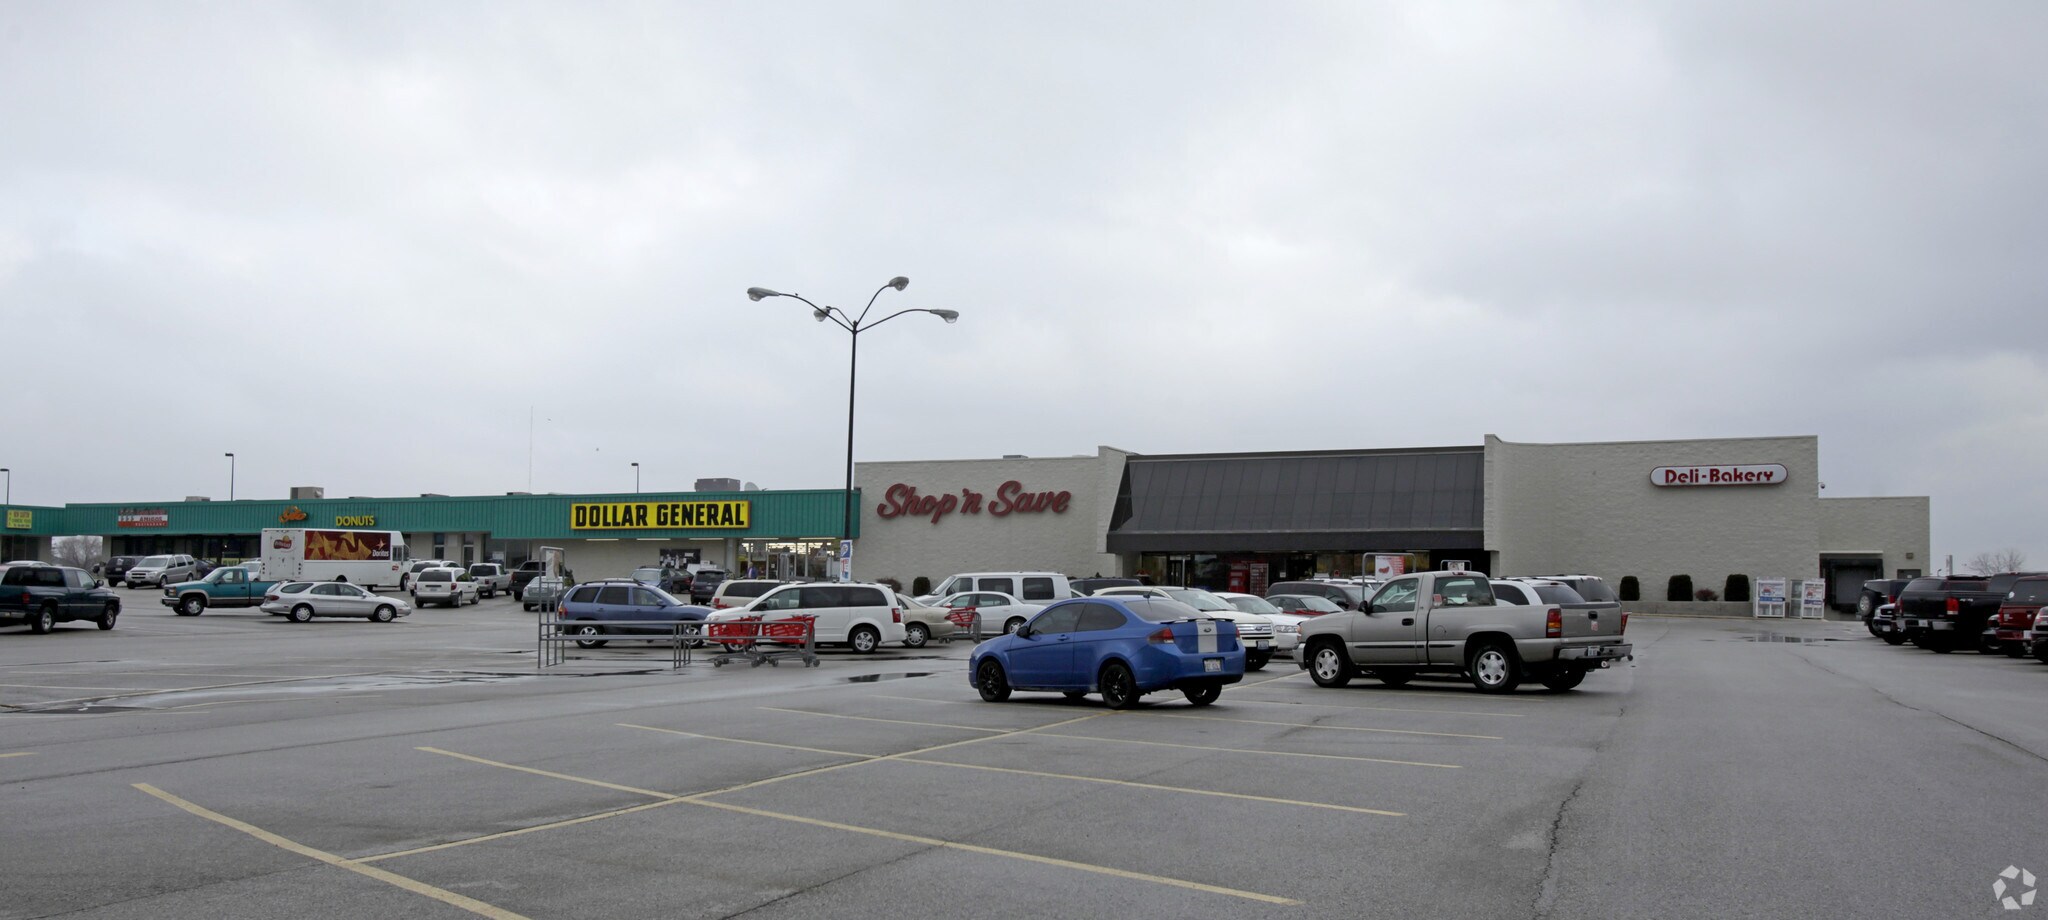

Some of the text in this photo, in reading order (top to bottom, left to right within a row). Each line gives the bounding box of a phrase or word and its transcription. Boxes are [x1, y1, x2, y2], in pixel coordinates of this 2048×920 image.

[876, 482, 959, 525] Shop
[987, 480, 1072, 518] Save
[335, 515, 375, 527] DONUTS
[575, 503, 745, 527] DOLLAR GENERAL
